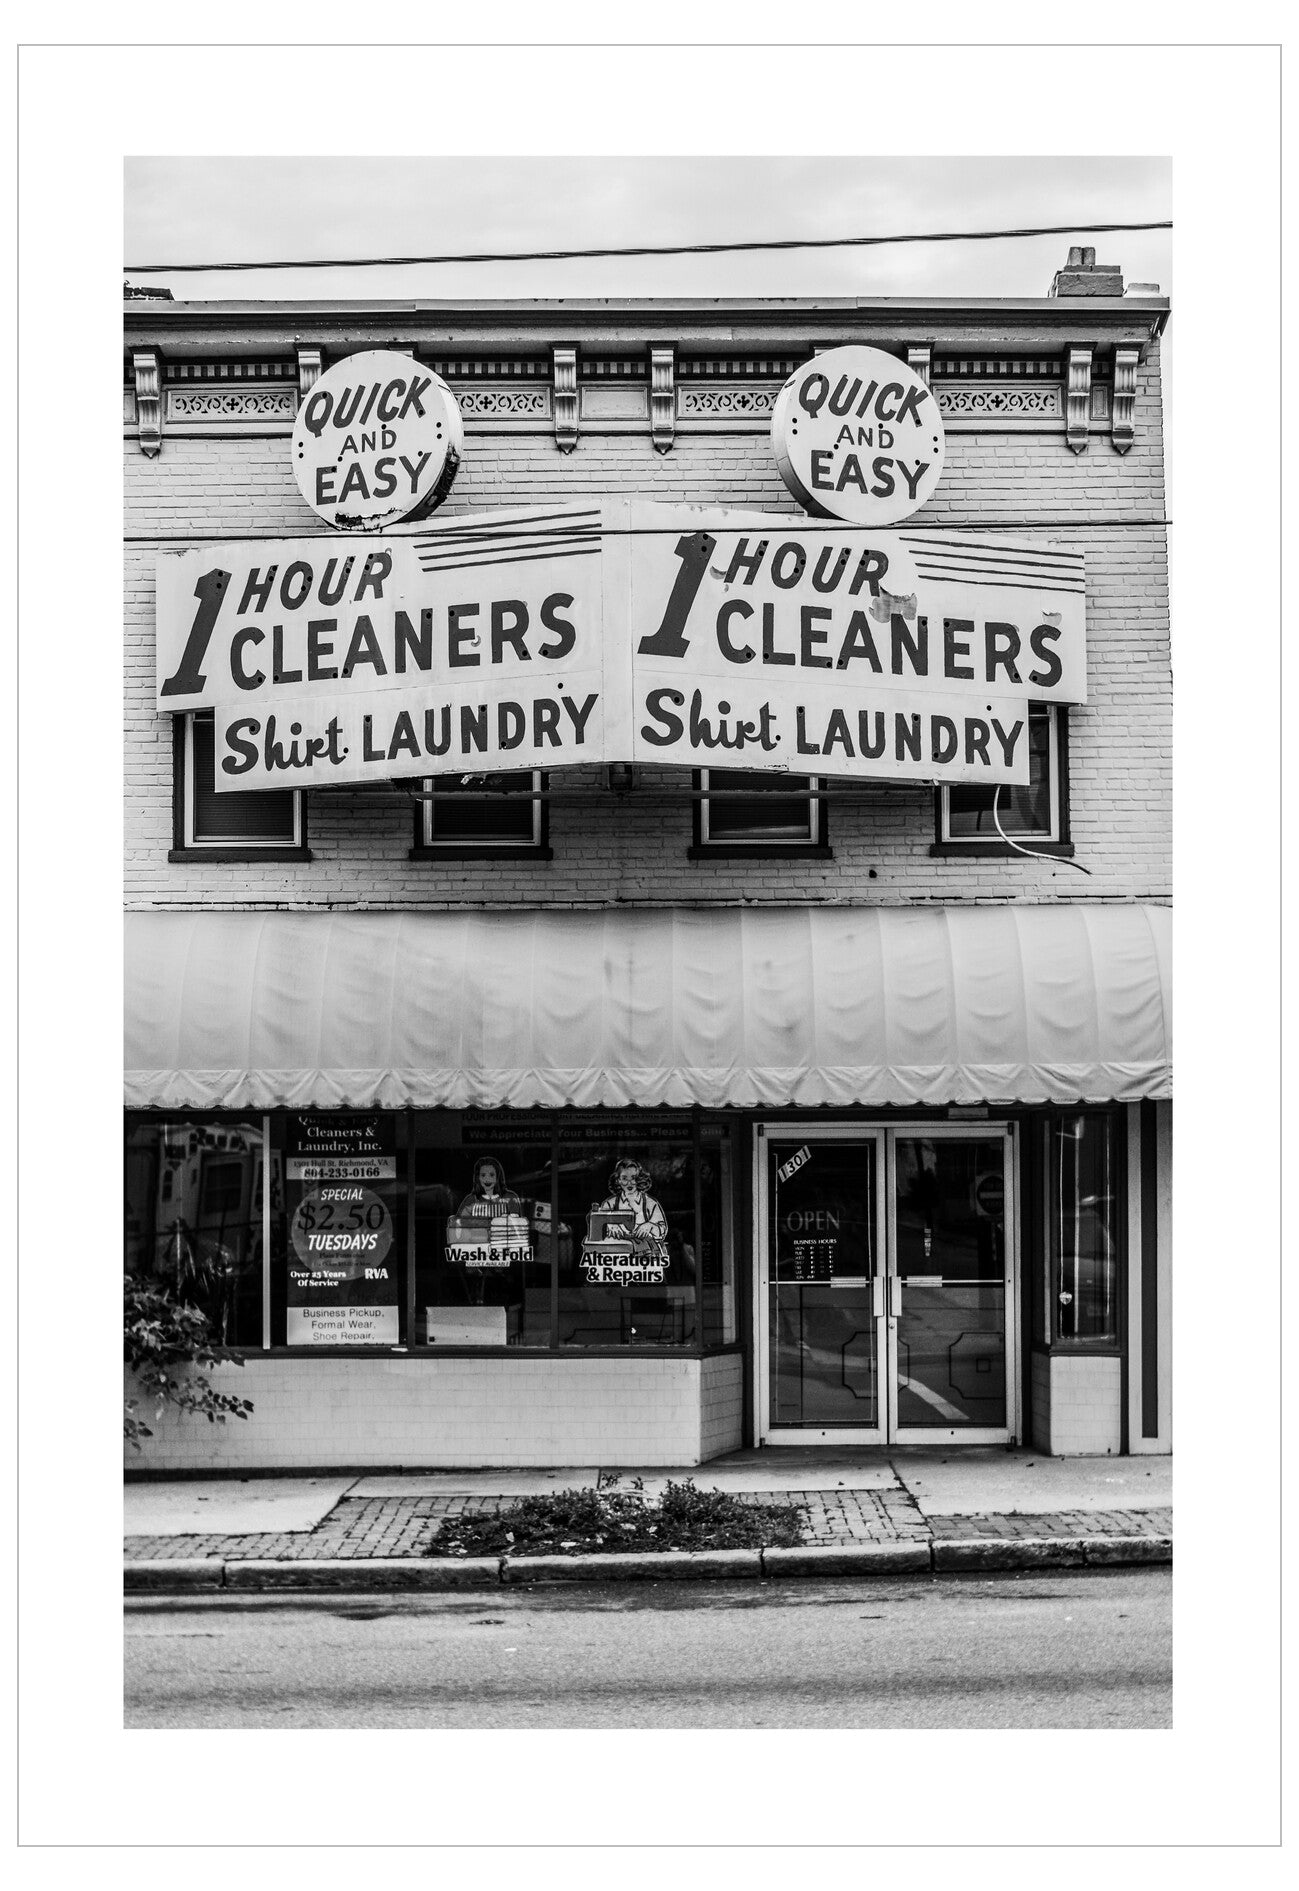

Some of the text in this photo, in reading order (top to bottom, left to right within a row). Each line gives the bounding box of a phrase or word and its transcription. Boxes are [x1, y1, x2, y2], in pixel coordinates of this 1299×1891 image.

[305, 376, 432, 437] QUICK
[799, 373, 929, 427] QUICK
[340, 430, 397, 456] AND
[836, 425, 894, 449] AND
[315, 452, 432, 506] EASY
[811, 450, 930, 500] EASY
[637, 532, 888, 658] 1 HOUR
[161, 552, 393, 697] 1 HOUR
[230, 592, 577, 692] CLEANERS
[716, 599, 1063, 688] CLEANERS
[222, 693, 599, 775] Shirt LAUNDRY
[640, 688, 1024, 767] Shirt LAUNDRY
[307, 1127, 375, 1138] Cleaners &
[469, 1129, 487, 1138] We
[558, 1128, 583, 1137] Your
[650, 1127, 689, 1136] Please
[298, 1141, 383, 1154] Laundry, Inc.
[378, 1158, 389, 1166] VA
[779, 1148, 810, 1180] 1301
[304, 1167, 380, 1178] 804-233-0166
[320, 1188, 364, 1201] SPECIAL
[297, 1202, 385, 1235] $2.50
[786, 1210, 840, 1231] OPEN
[308, 1233, 378, 1251] TUESDAYS
[446, 1247, 533, 1261] Wash & Fold
[581, 1252, 669, 1268] Alterations
[290, 1270, 310, 1278] Over
[323, 1270, 347, 1279] Years
[297, 1279, 339, 1287] Of Service
[364, 1267, 389, 1280] RVA
[587, 1267, 663, 1286] & Repairs
[303, 1308, 346, 1318] Business
[312, 1320, 376, 1330] Formal Wear,
[313, 1331, 375, 1341] Shoe Repair,
